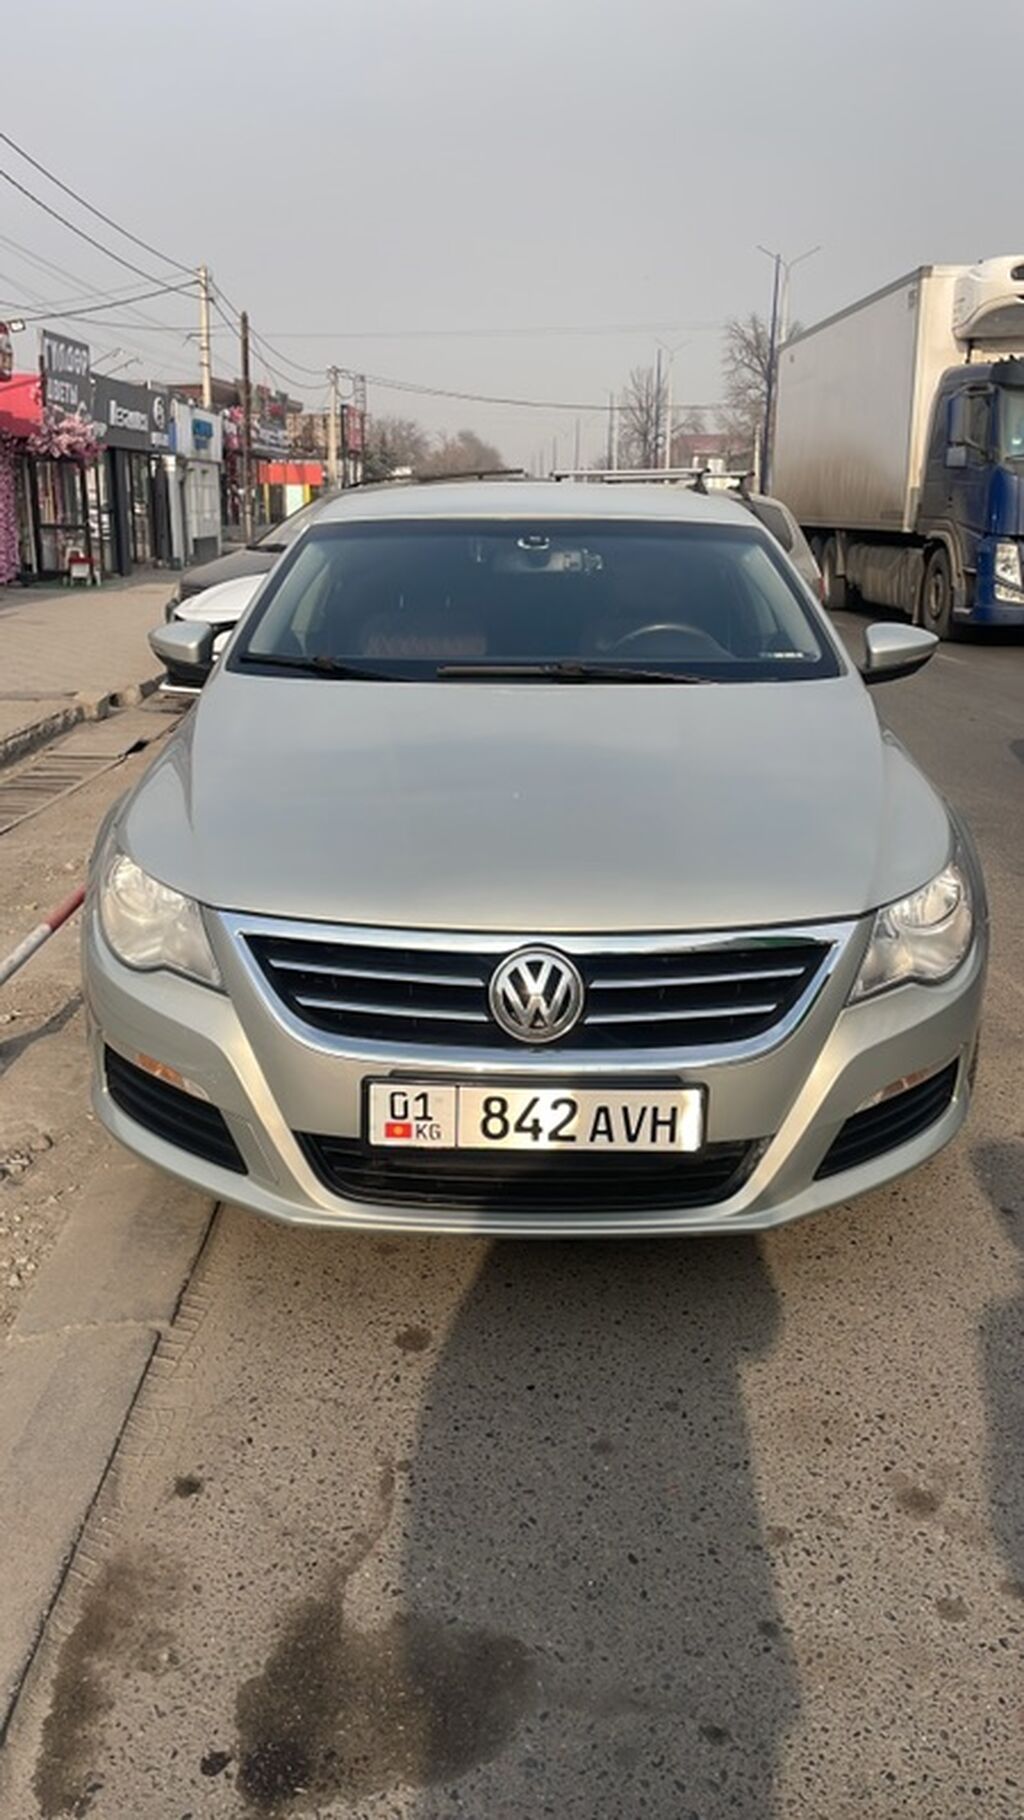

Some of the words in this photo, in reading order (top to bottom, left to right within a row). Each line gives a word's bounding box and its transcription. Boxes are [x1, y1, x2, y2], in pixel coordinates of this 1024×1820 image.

[494, 952, 577, 1036] VW
[390, 1091, 433, 1121] 01
[480, 1096, 578, 1143] 842
[589, 1105, 677, 1143] AVH
[416, 1123, 441, 1141] KG
